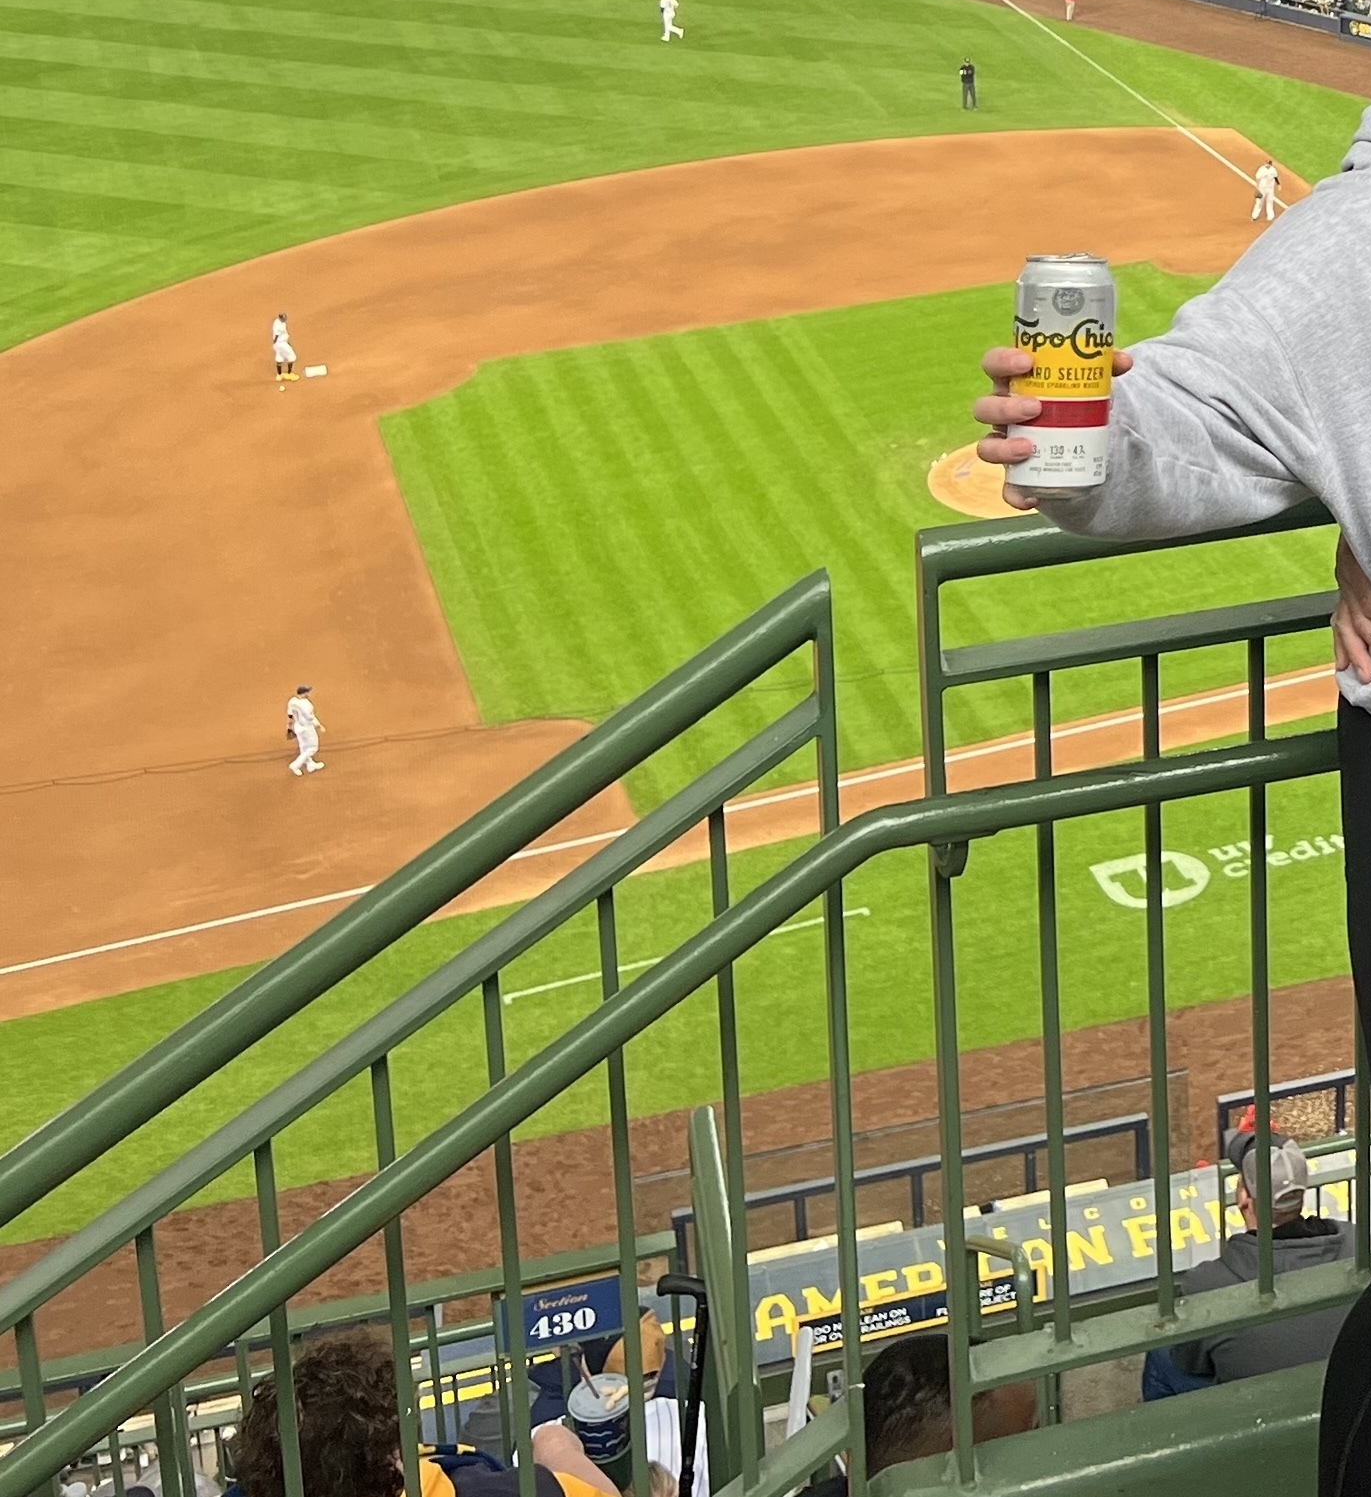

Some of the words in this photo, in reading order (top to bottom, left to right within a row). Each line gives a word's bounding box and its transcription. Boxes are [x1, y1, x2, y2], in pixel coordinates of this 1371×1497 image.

[1057, 366, 1105, 381] SELTZER
[533, 1293, 589, 1312] Section
[529, 1307, 597, 1340] 430
[813, 1324, 832, 1336] DO
[888, 1307, 907, 1320] ON
[860, 1315, 912, 1334] RAILINGS
